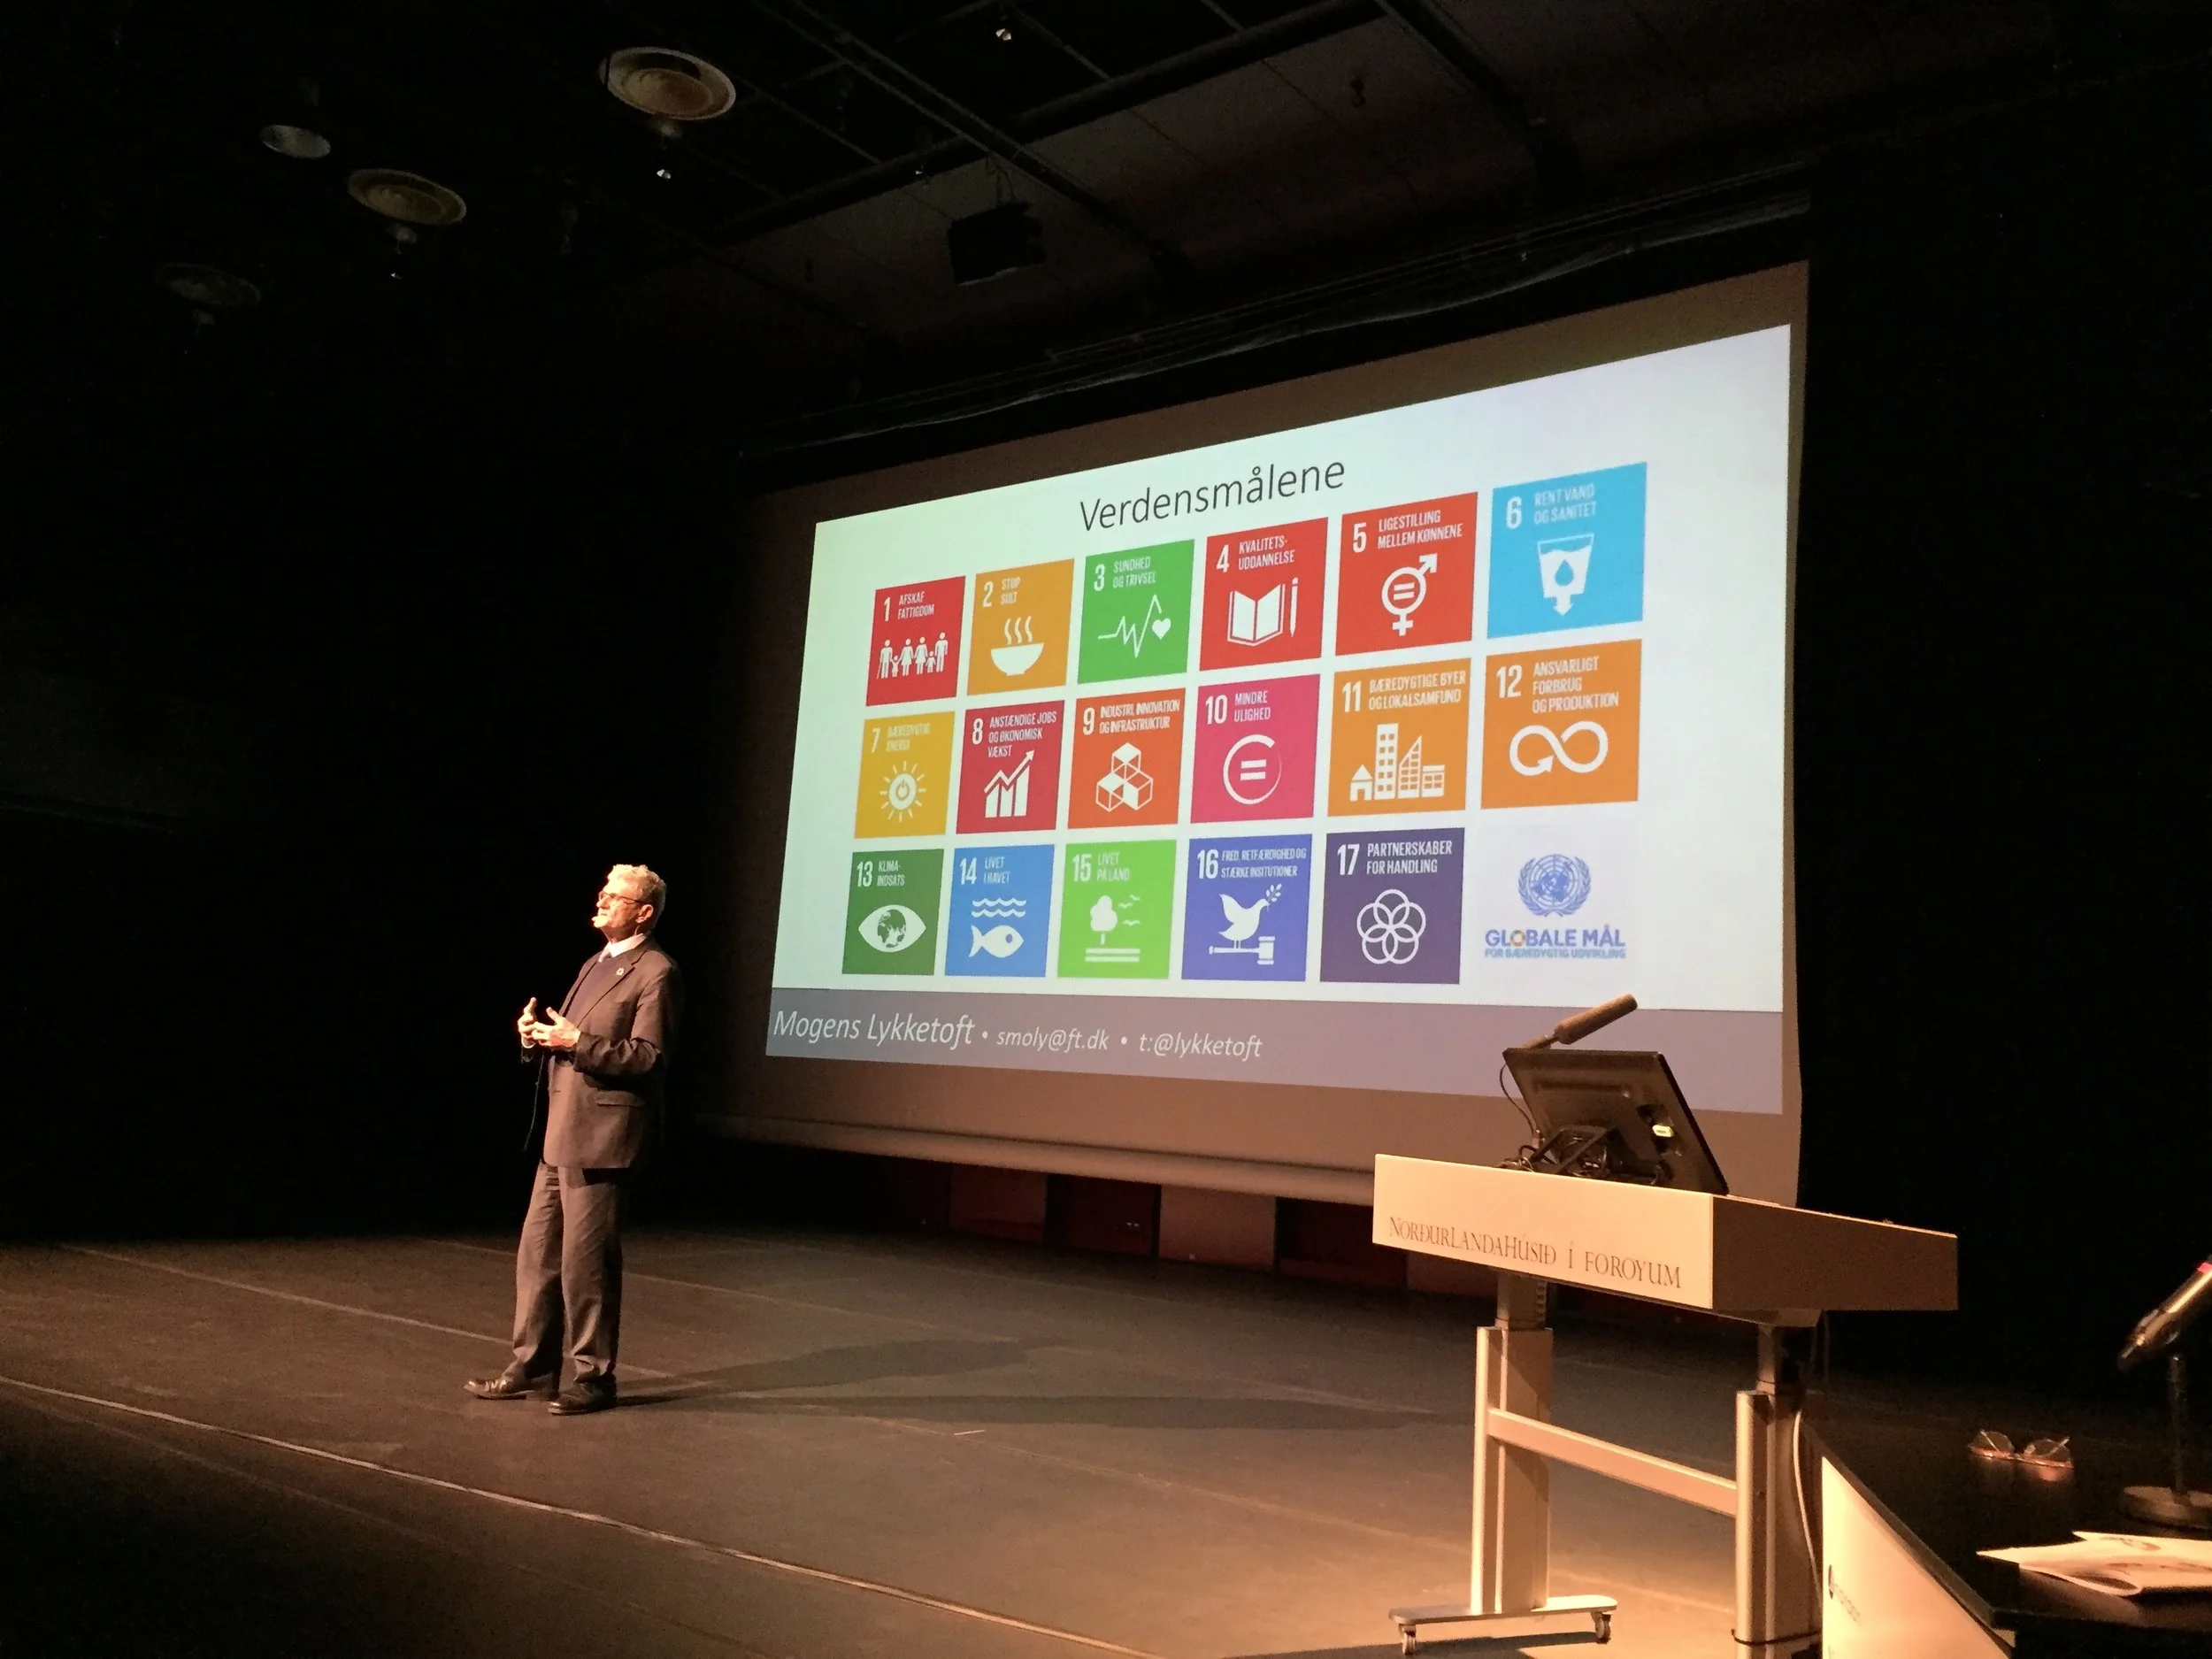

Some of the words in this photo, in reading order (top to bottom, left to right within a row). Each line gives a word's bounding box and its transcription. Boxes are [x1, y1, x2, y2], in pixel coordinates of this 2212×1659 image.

[1080, 462, 1345, 532] Verdensmålene
[1534, 488, 1563, 507] RENT
[1564, 483, 1595, 503] VAND
[1378, 510, 1441, 532] LIGESTILLING
[1506, 496, 1523, 529] 6
[1533, 505, 1549, 525] OG
[1550, 501, 1597, 523] SANITET
[1239, 535, 1288, 554] KVALITETS-
[1352, 522, 1367, 553] 5
[1378, 531, 1416, 549] MELLEM
[1417, 523, 1463, 543] KØNNENE
[1113, 556, 1151, 573] SUNDHED
[1216, 544, 1230, 573] 4
[1238, 549, 1295, 571] UDDANNELSE
[1002, 577, 1021, 591] STOP
[1094, 564, 1105, 591] 3
[1112, 575, 1125, 588] OG
[1125, 571, 1156, 588] TRIVSEL
[898, 591, 925, 606] AFSKAF
[982, 581, 995, 608] 2
[884, 596, 891, 621] 1
[897, 603, 935, 620] FATTIGDOM
[1532, 655, 1600, 675] ANSVARLIGT
[1369, 673, 1439, 695] BÆREDYGTIGE
[1440, 670, 1466, 686] BYER
[1496, 664, 1523, 698] 12
[1532, 676, 1583, 696] FORBRUG
[1136, 699, 1180, 715] INNOVATION
[1234, 690, 1268, 706] MINDRE
[1341, 680, 1363, 713] 11
[1368, 695, 1382, 710] OG
[1383, 688, 1462, 710] LOKALSAMFUND
[1532, 698, 1547, 713] OG
[1548, 692, 1619, 712] PRODUKTION
[989, 712, 1037, 728] ANSTÆNDIGE
[1037, 710, 1057, 724] JOBS
[1082, 707, 1095, 735] 9
[1205, 695, 1228, 725] 10
[1233, 707, 1271, 722] ULIGHED
[972, 718, 984, 745] 8
[988, 731, 999, 743] OG
[999, 727, 1043, 742] ØKONOMISK
[1099, 721, 1110, 734] OG
[1110, 716, 1171, 733] INFRASTRUKTUR
[871, 727, 881, 753] 7
[987, 744, 1012, 758] VÆKST
[1097, 852, 1120, 866] LIVET
[1295, 847, 1307, 859] OG
[1367, 841, 1453, 856] PARTNERSKABER
[959, 856, 978, 885] 14
[985, 856, 1005, 870] LIVET
[1071, 853, 1093, 882] 15
[1197, 849, 1219, 879] 16
[1337, 844, 1360, 876] 17
[1366, 860, 1386, 875] FOR
[1386, 859, 1438, 874] HANDLING
[856, 861, 873, 887] 13
[987, 871, 1011, 884] HAVET
[1485, 928, 1577, 947] GLOBALE
[1582, 924, 1625, 947] MÅL
[773, 1010, 862, 1044] Mogens
[867, 1012, 975, 1051] Lykketoft
[996, 1026, 1110, 1053] smoly@ft.dk
[1139, 1033, 1263, 1063] t:@lykketoft
